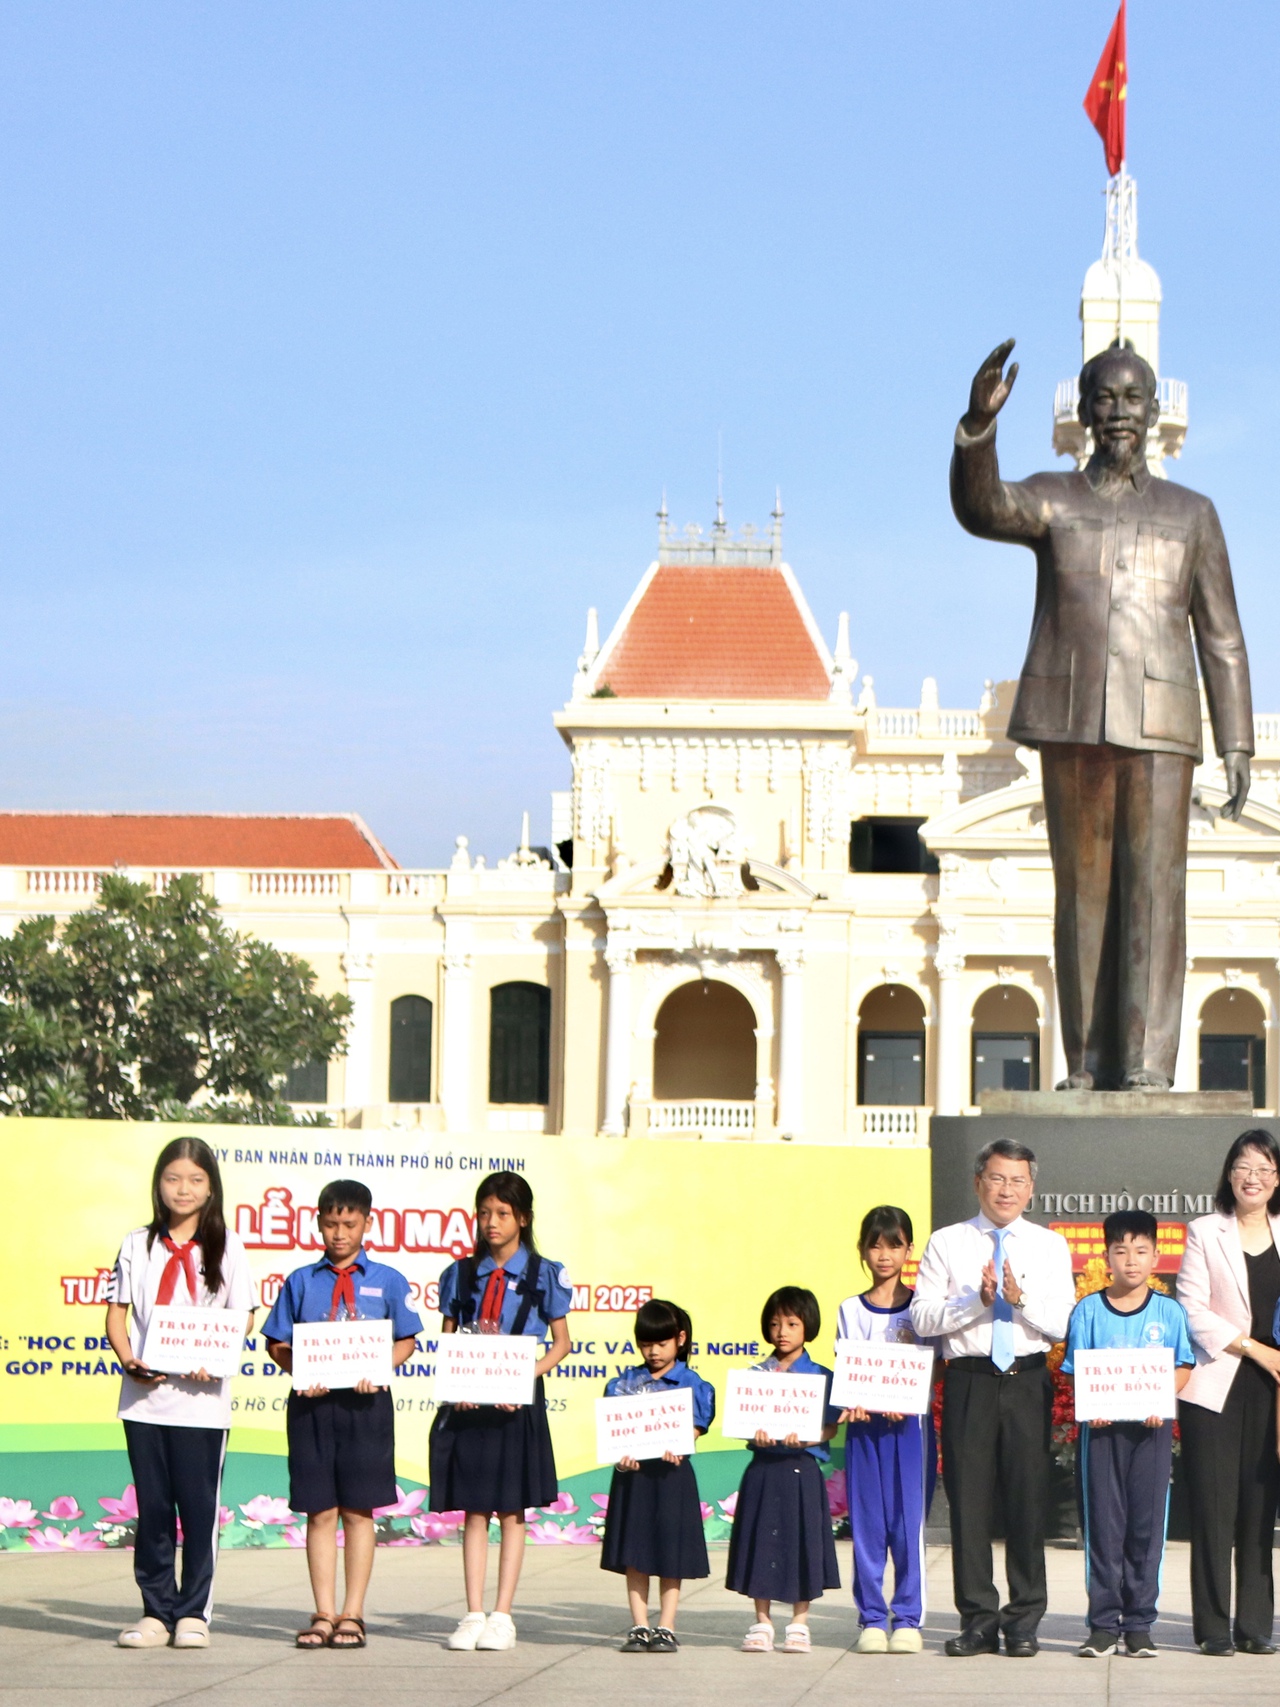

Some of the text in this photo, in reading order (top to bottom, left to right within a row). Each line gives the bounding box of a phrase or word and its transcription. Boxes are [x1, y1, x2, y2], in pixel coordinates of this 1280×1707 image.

[234, 1149, 263, 1164] BAN
[269, 1147, 309, 1166] NHÂN
[314, 1149, 342, 1166] DÂN
[348, 1150, 395, 1168] THÀNH
[400, 1150, 430, 1169] PHỐ
[435, 1151, 454, 1170] HỒ
[459, 1153, 483, 1171] CHÍ
[489, 1157, 525, 1172] MINH
[1040, 1194, 1095, 1216] TỊCH
[1100, 1187, 1134, 1214] HỒ
[1137, 1189, 1178, 1214] CHÍ
[1183, 1194, 1218, 1214] MI
[236, 1186, 477, 1259] LỄ KAI MẠ
[61, 1267, 112, 1305] TUẦ
[594, 1285, 653, 1312] 2025
[158, 1320, 196, 1331] TRAO
[302, 1337, 341, 1347] TRAO
[543, 1338, 635, 1355] TỨC VÀ
[447, 1350, 485, 1360] TRAO
[844, 1355, 883, 1367] TRAO
[6, 1358, 53, 1375] GÓP
[1083, 1366, 1123, 1376] TRAO
[735, 1386, 774, 1397] TRAO
[396, 1398, 413, 1412] 01
[545, 1398, 567, 1412] 25
[605, 1410, 643, 1422] TRAO
